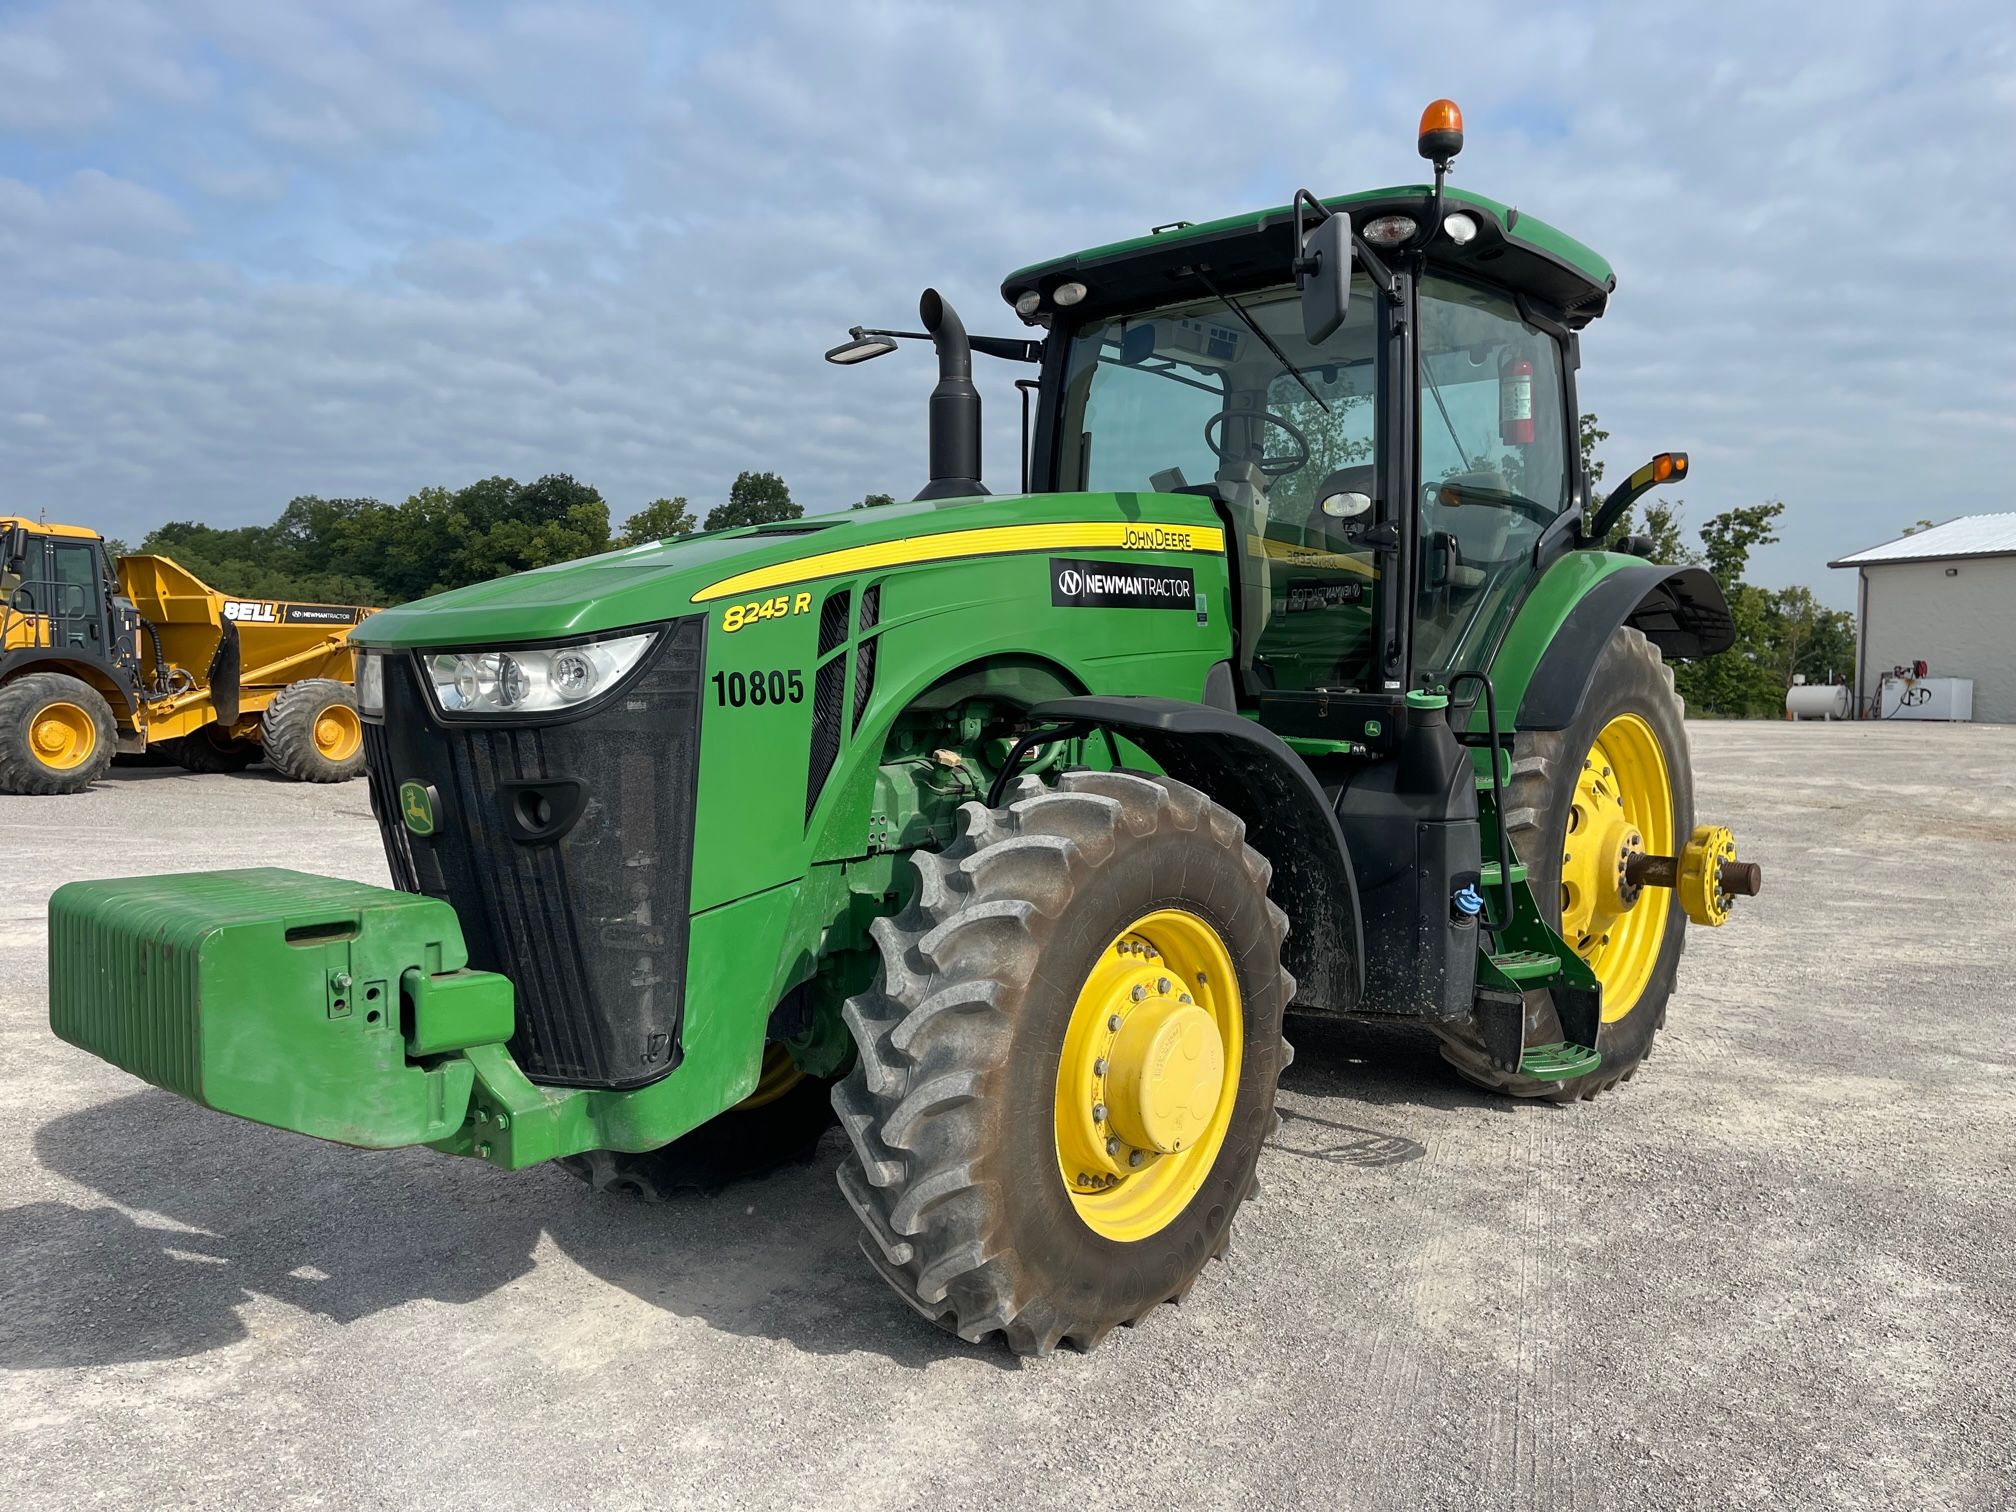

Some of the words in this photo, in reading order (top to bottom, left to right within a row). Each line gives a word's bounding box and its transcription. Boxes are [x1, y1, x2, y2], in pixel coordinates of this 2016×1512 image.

[1122, 527, 1154, 547] JOHN
[1154, 528, 1193, 549] DEERE
[1086, 573, 1191, 598] NEWMANTRACTOR
[223, 600, 277, 622] BELL
[722, 596, 791, 633] 8245
[793, 591, 812, 615] R
[711, 668, 804, 708] 10805
